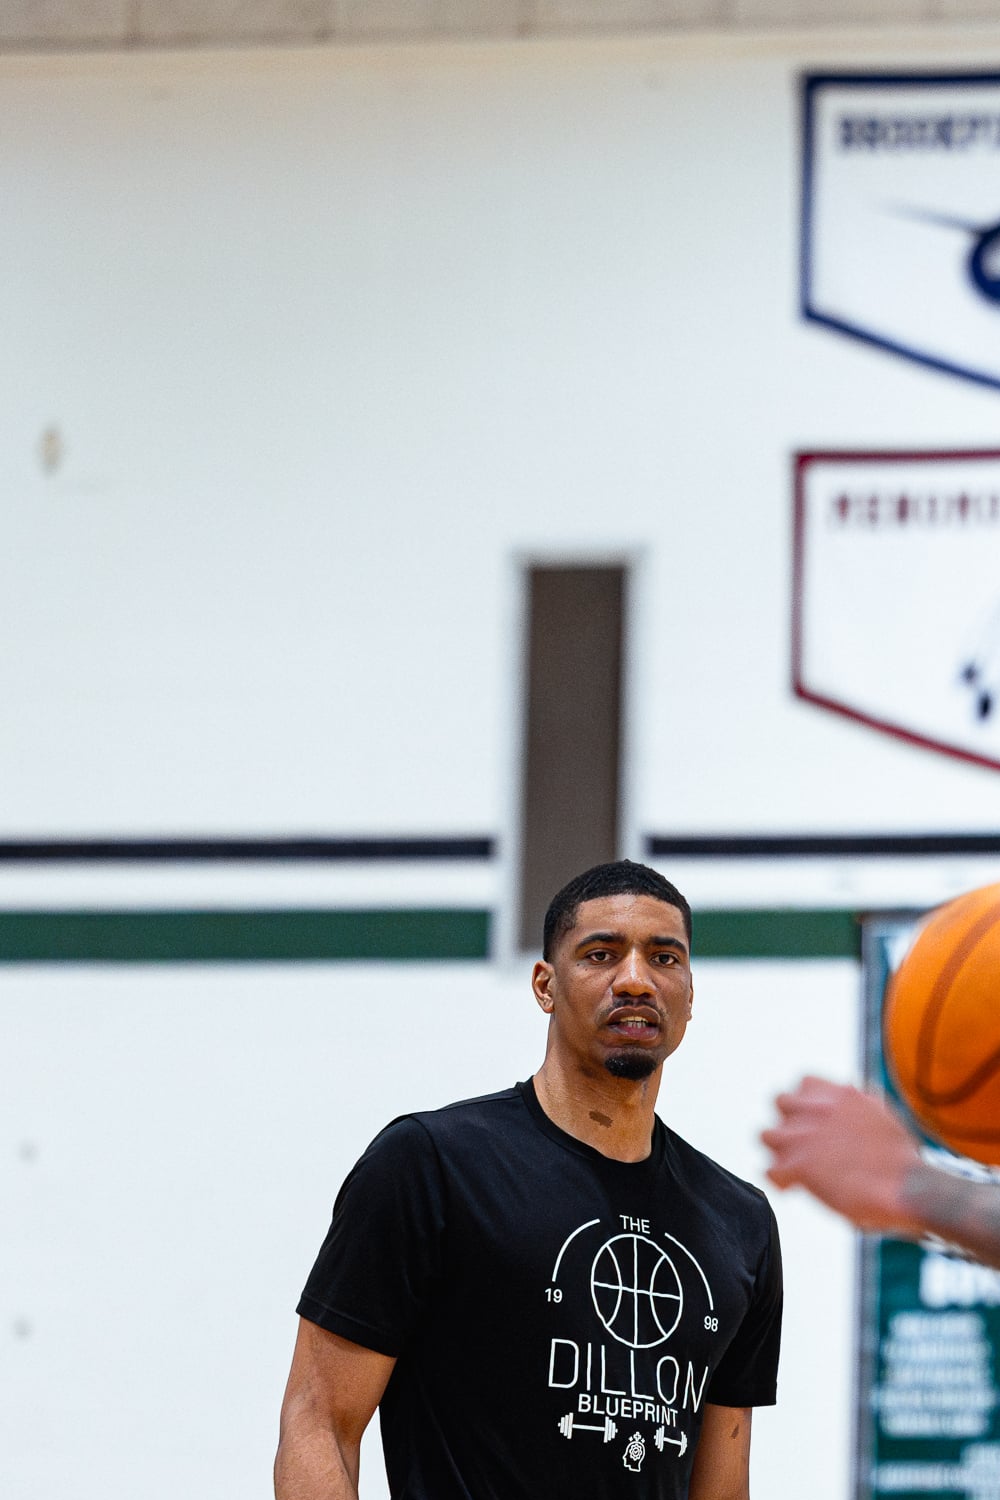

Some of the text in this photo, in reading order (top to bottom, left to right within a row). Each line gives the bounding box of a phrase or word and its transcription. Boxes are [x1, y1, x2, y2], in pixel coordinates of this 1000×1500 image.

[619, 1214, 651, 1234] THE
[544, 1288, 563, 1303] 19
[704, 1315, 719, 1332] 98
[548, 1338, 709, 1413] DILLON
[578, 1393, 678, 1427] BLUEPRINT
